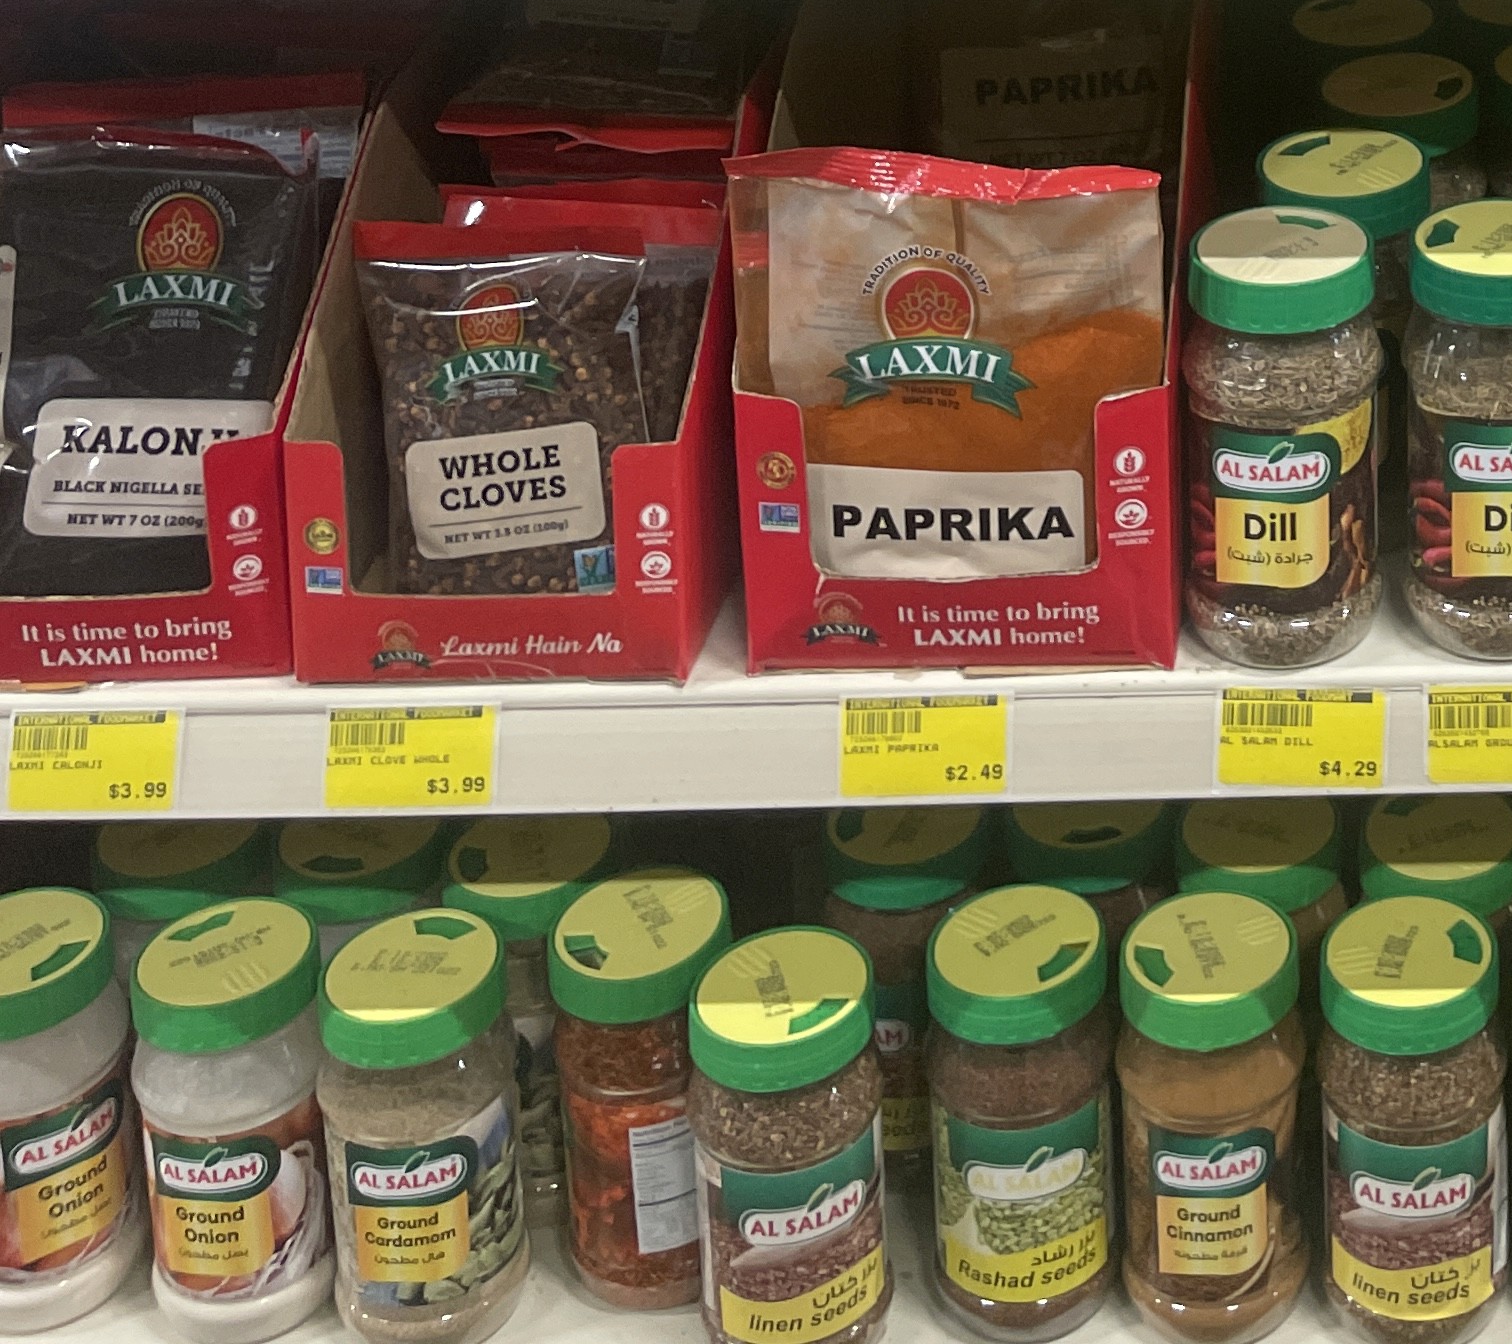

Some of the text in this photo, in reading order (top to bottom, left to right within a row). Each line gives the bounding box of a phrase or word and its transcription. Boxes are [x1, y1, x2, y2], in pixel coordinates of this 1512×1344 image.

[113, 275, 237, 307] LAXMI
[443, 348, 541, 383] LAXMI
[855, 342, 1002, 383] LAXMI
[438, 443, 561, 480] WHOLE
[53, 479, 174, 496] BLACK NIGELLA
[440, 474, 568, 511] CLOVES
[831, 503, 1076, 542] PAPRIKA
[1244, 510, 1298, 543] Dill
[898, 601, 1100, 625] It is time to bring
[913, 626, 1085, 646] LAXMI home!
[427, 774, 486, 796] $3.99
[944, 762, 1004, 783] $2.49
[364, 1227, 457, 1249] Cardamom
[377, 1213, 439, 1232] Ground
[957, 1246, 1099, 1291] Rashad seeds
[1352, 1270, 1471, 1307] linen seeds
